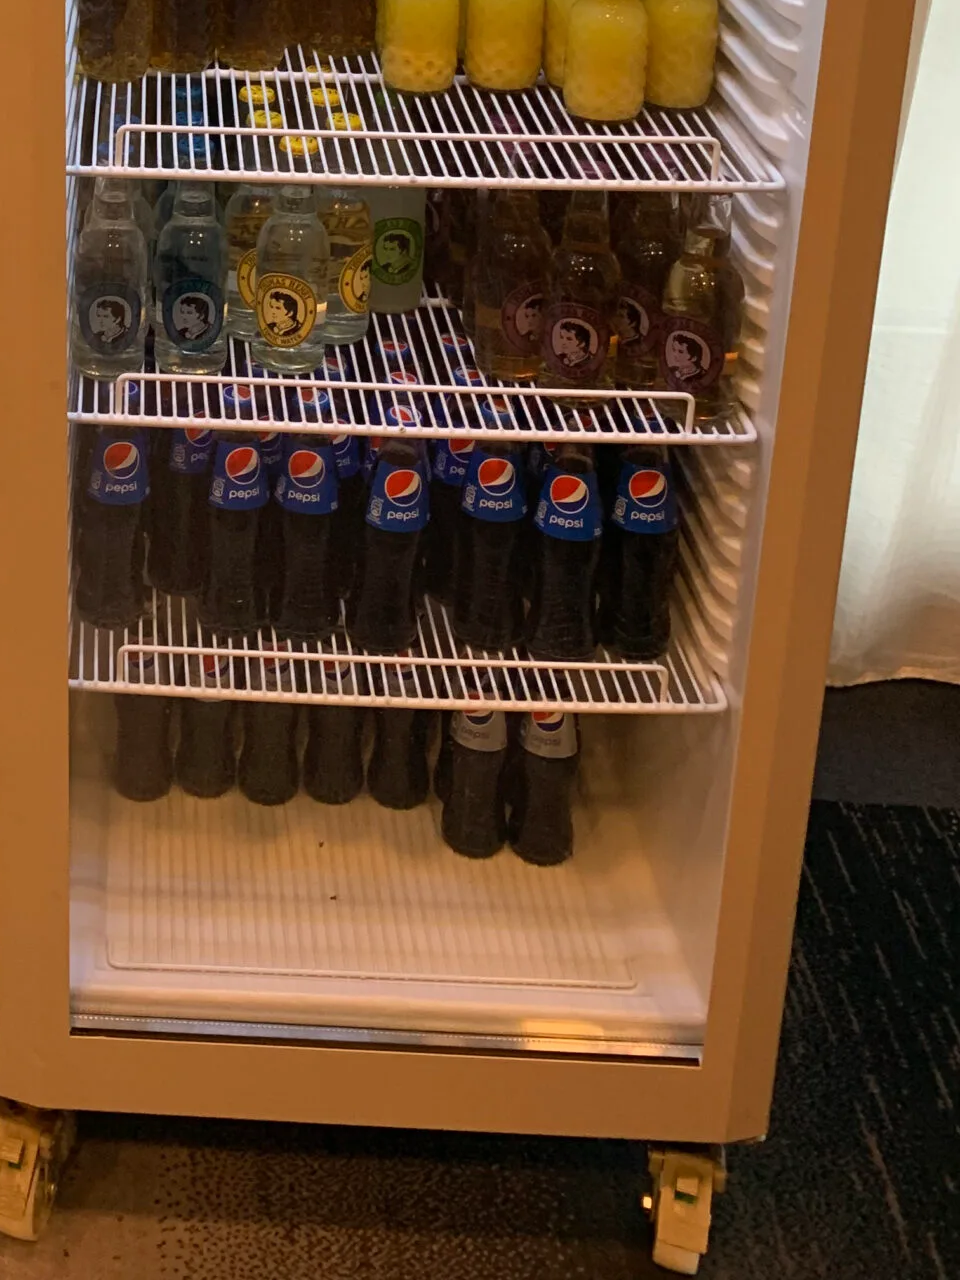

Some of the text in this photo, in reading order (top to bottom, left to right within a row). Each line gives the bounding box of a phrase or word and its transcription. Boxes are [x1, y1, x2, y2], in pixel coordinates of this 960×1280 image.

[105, 481, 138, 495] pepsi
[228, 487, 260, 500] pepsi
[287, 489, 320, 504] pepsi
[479, 498, 513, 511] pepsi
[387, 509, 420, 522] pepsi
[549, 513, 584, 529] pepsi
[630, 510, 665, 523] pepsi
